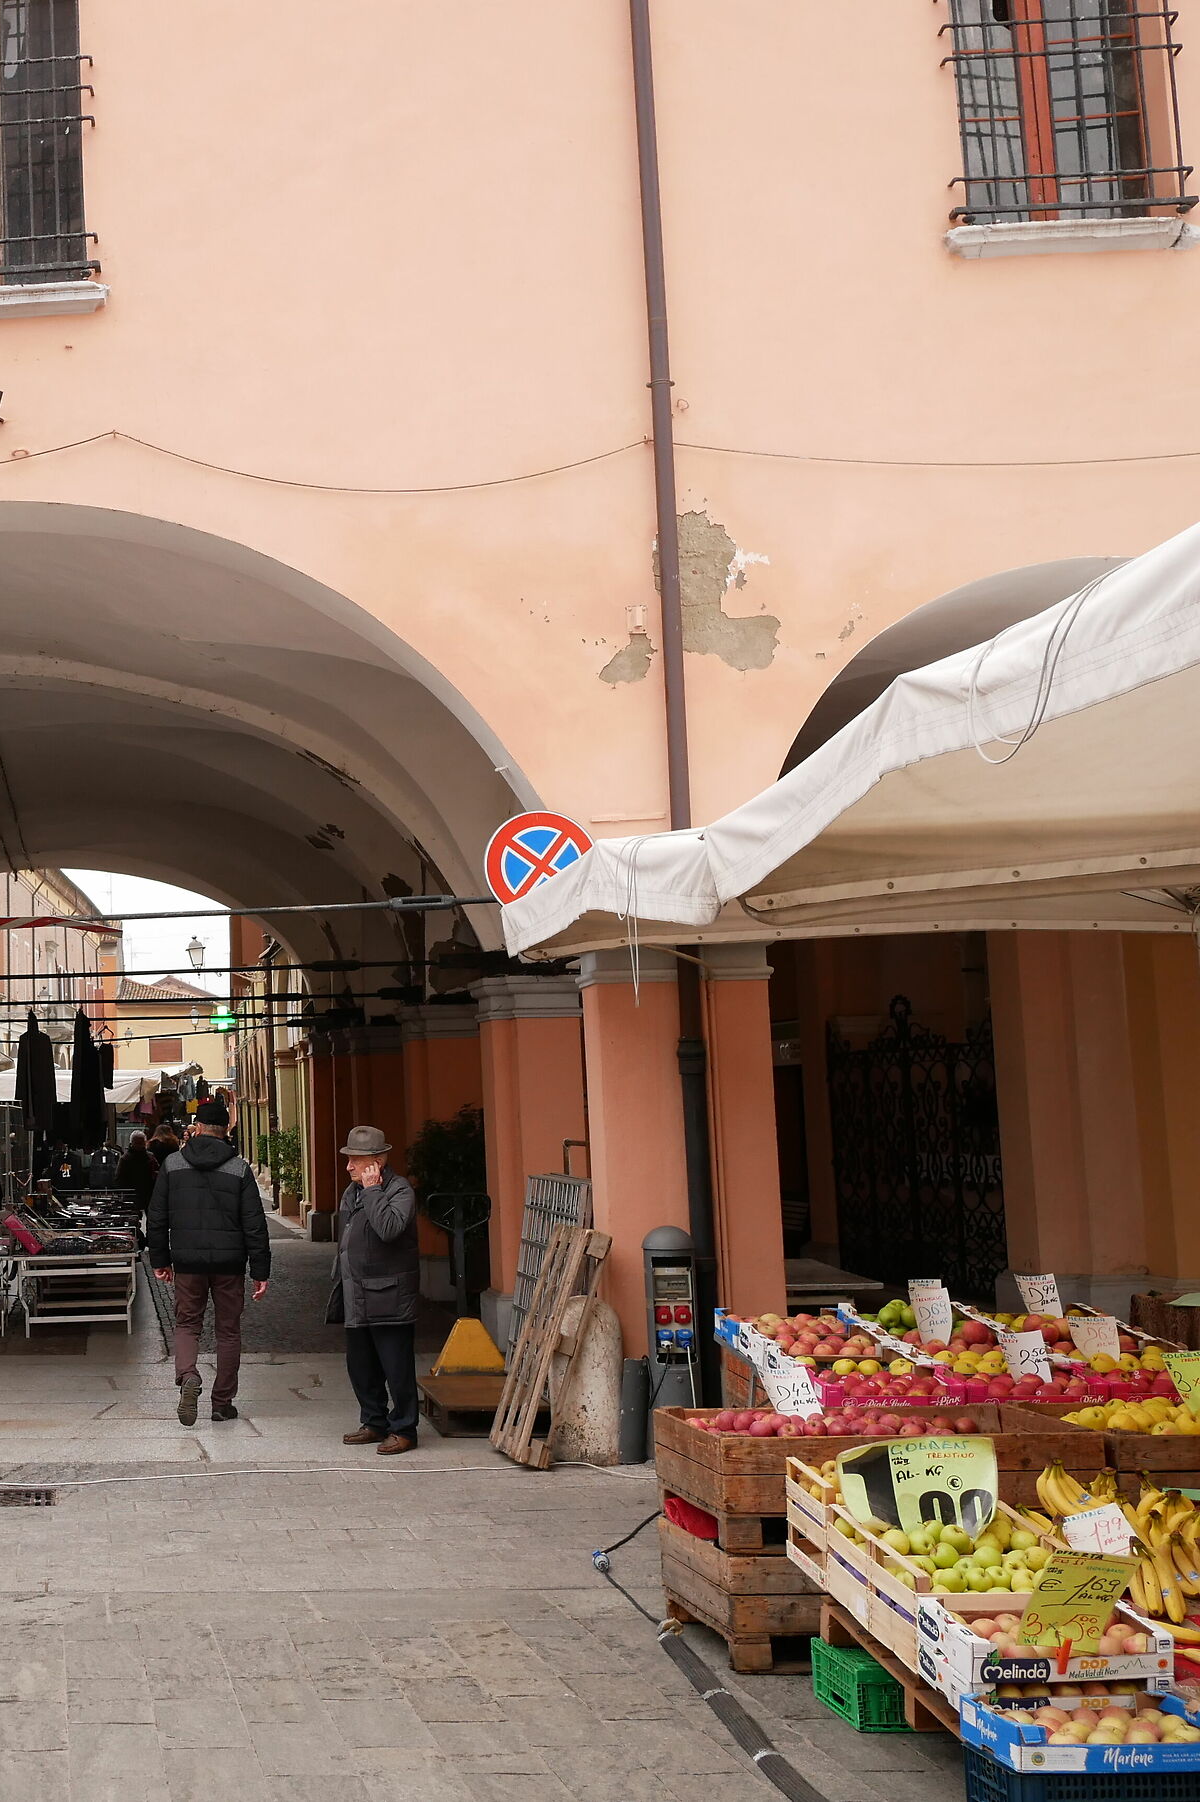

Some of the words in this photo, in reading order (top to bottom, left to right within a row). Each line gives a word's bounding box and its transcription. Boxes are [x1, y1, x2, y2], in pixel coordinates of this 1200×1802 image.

[62, 1169, 71, 1178] 21
[859, 1397, 888, 1408] Pink
[1022, 1612, 1043, 1637] 3
[983, 1662, 1048, 1680] Melinda
[1068, 1670, 1085, 1679] Mela
[1084, 1669, 1097, 1678] Val
[1104, 1666, 1119, 1676] Non
[1103, 1747, 1154, 1772] Marlene
